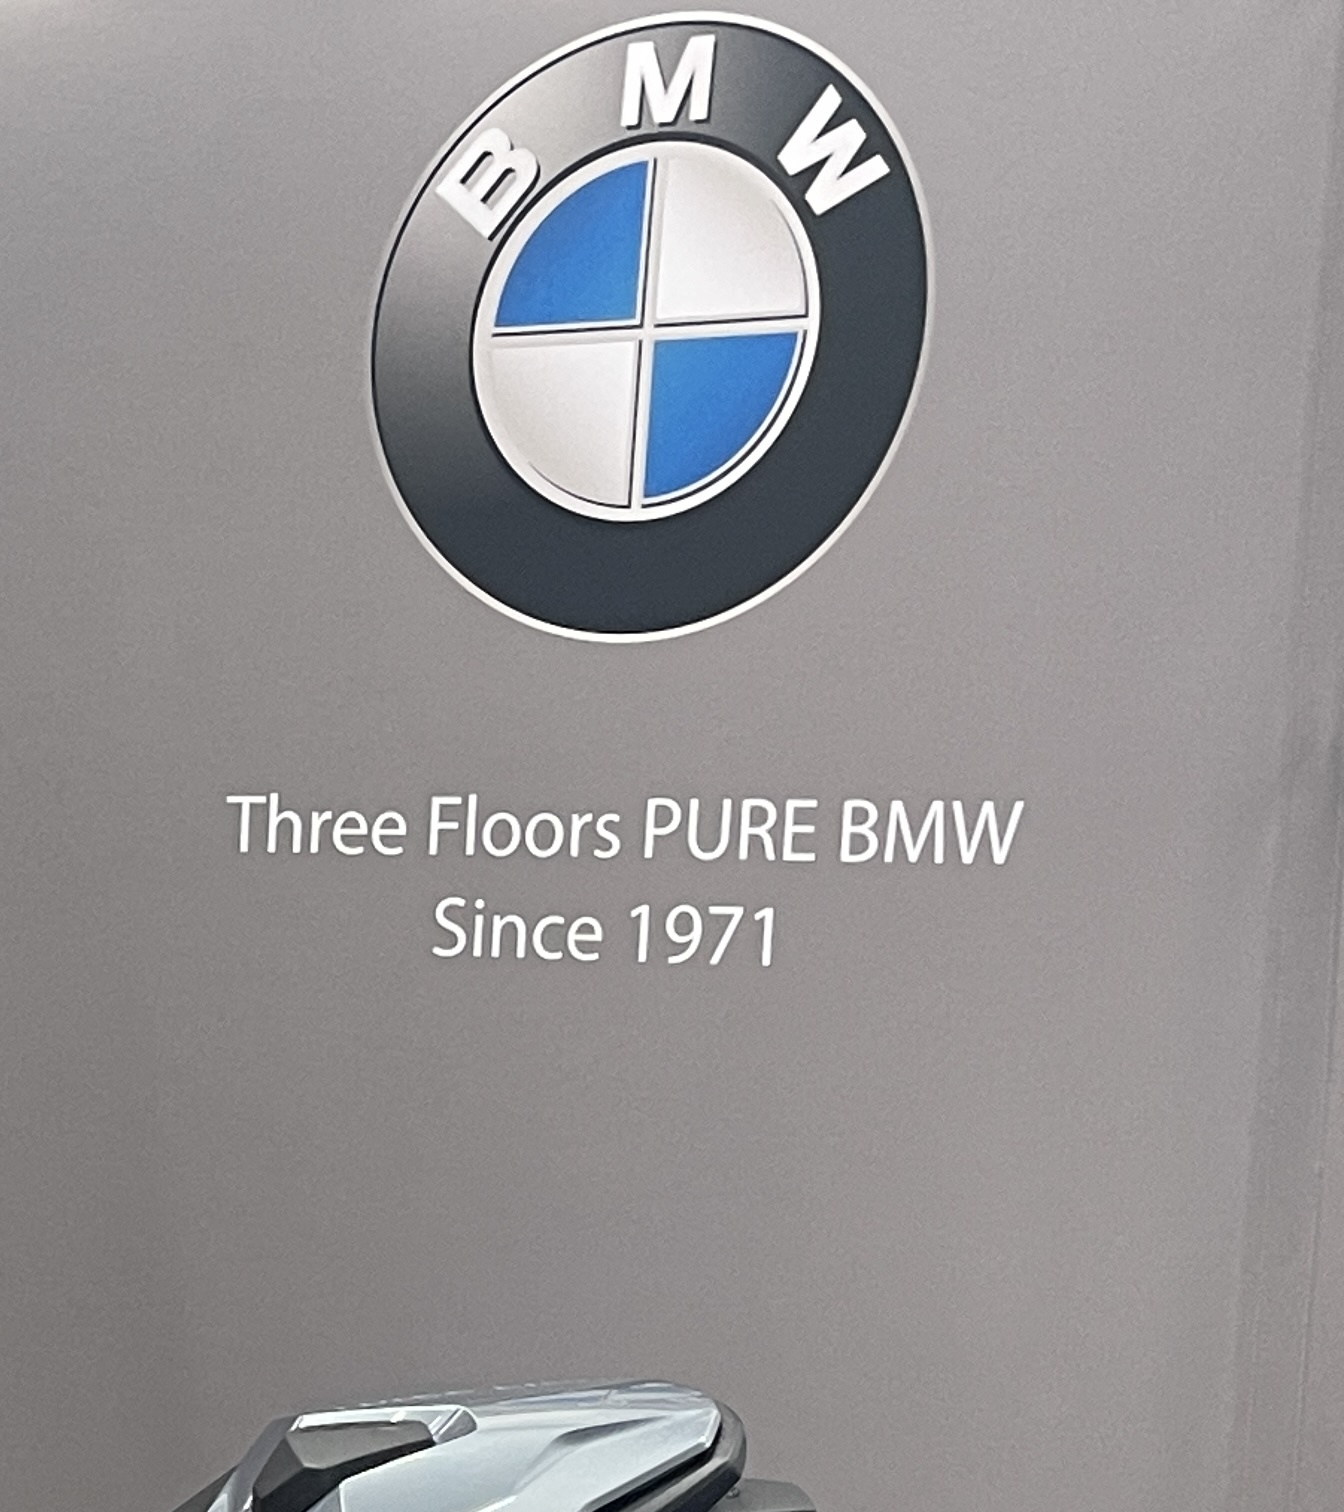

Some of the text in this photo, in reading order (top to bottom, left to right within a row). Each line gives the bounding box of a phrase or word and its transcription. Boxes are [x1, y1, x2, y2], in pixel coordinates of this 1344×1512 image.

[435, 33, 890, 238] BMW
[226, 792, 1025, 865] Three Floors PURE BMW
[432, 896, 775, 967] Since 1971
